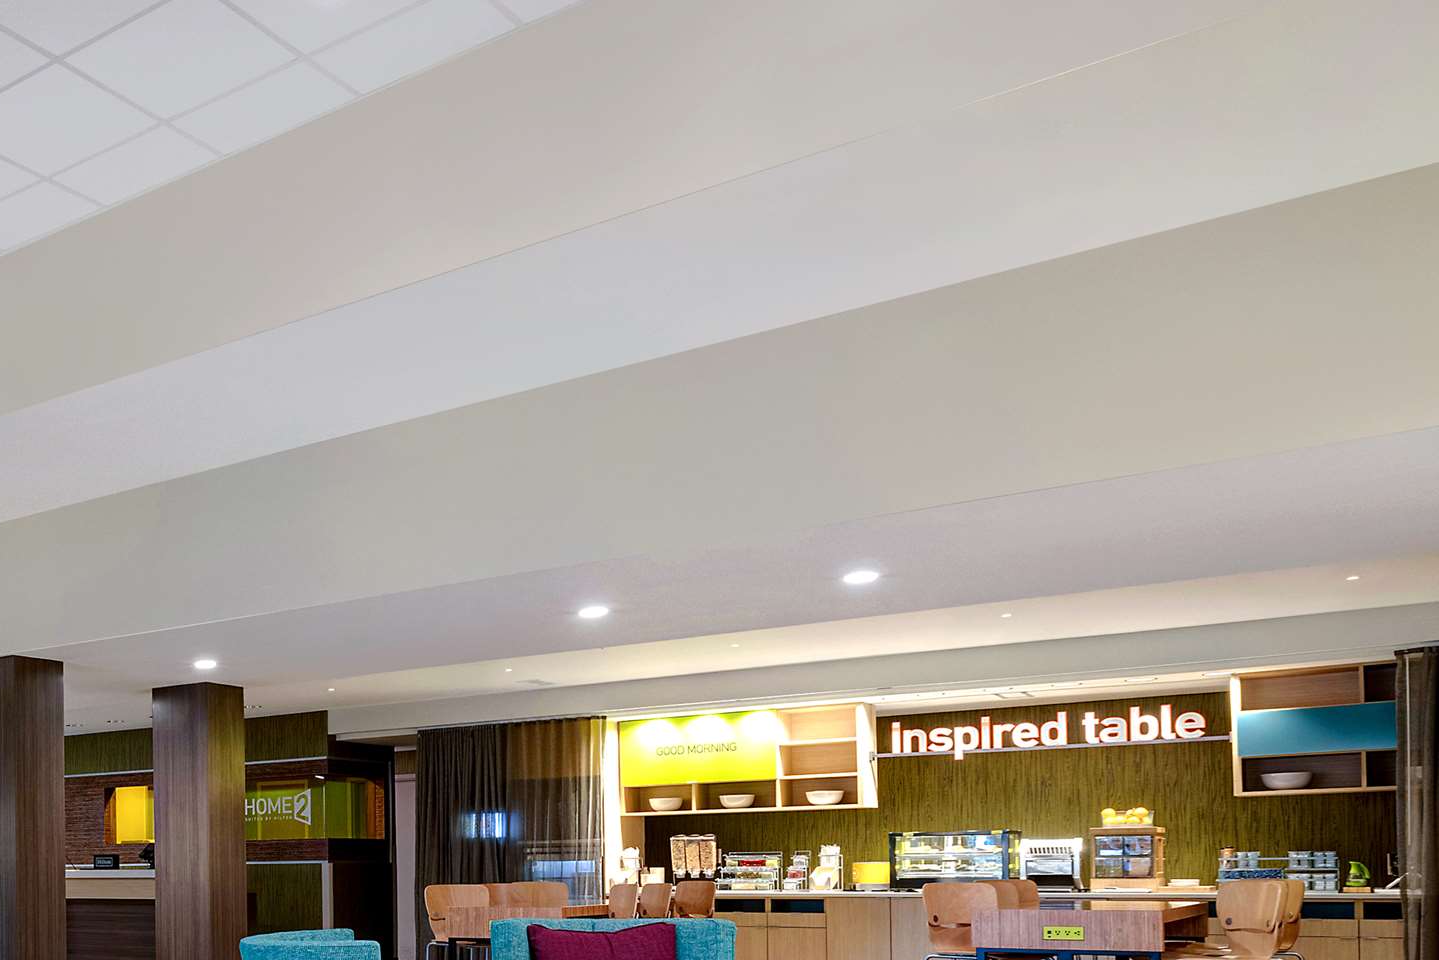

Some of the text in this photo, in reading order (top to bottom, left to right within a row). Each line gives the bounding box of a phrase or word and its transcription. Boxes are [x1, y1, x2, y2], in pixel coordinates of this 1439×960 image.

[656, 742, 738, 756] GOOD MORNING
[891, 704, 1206, 760] inspired table
